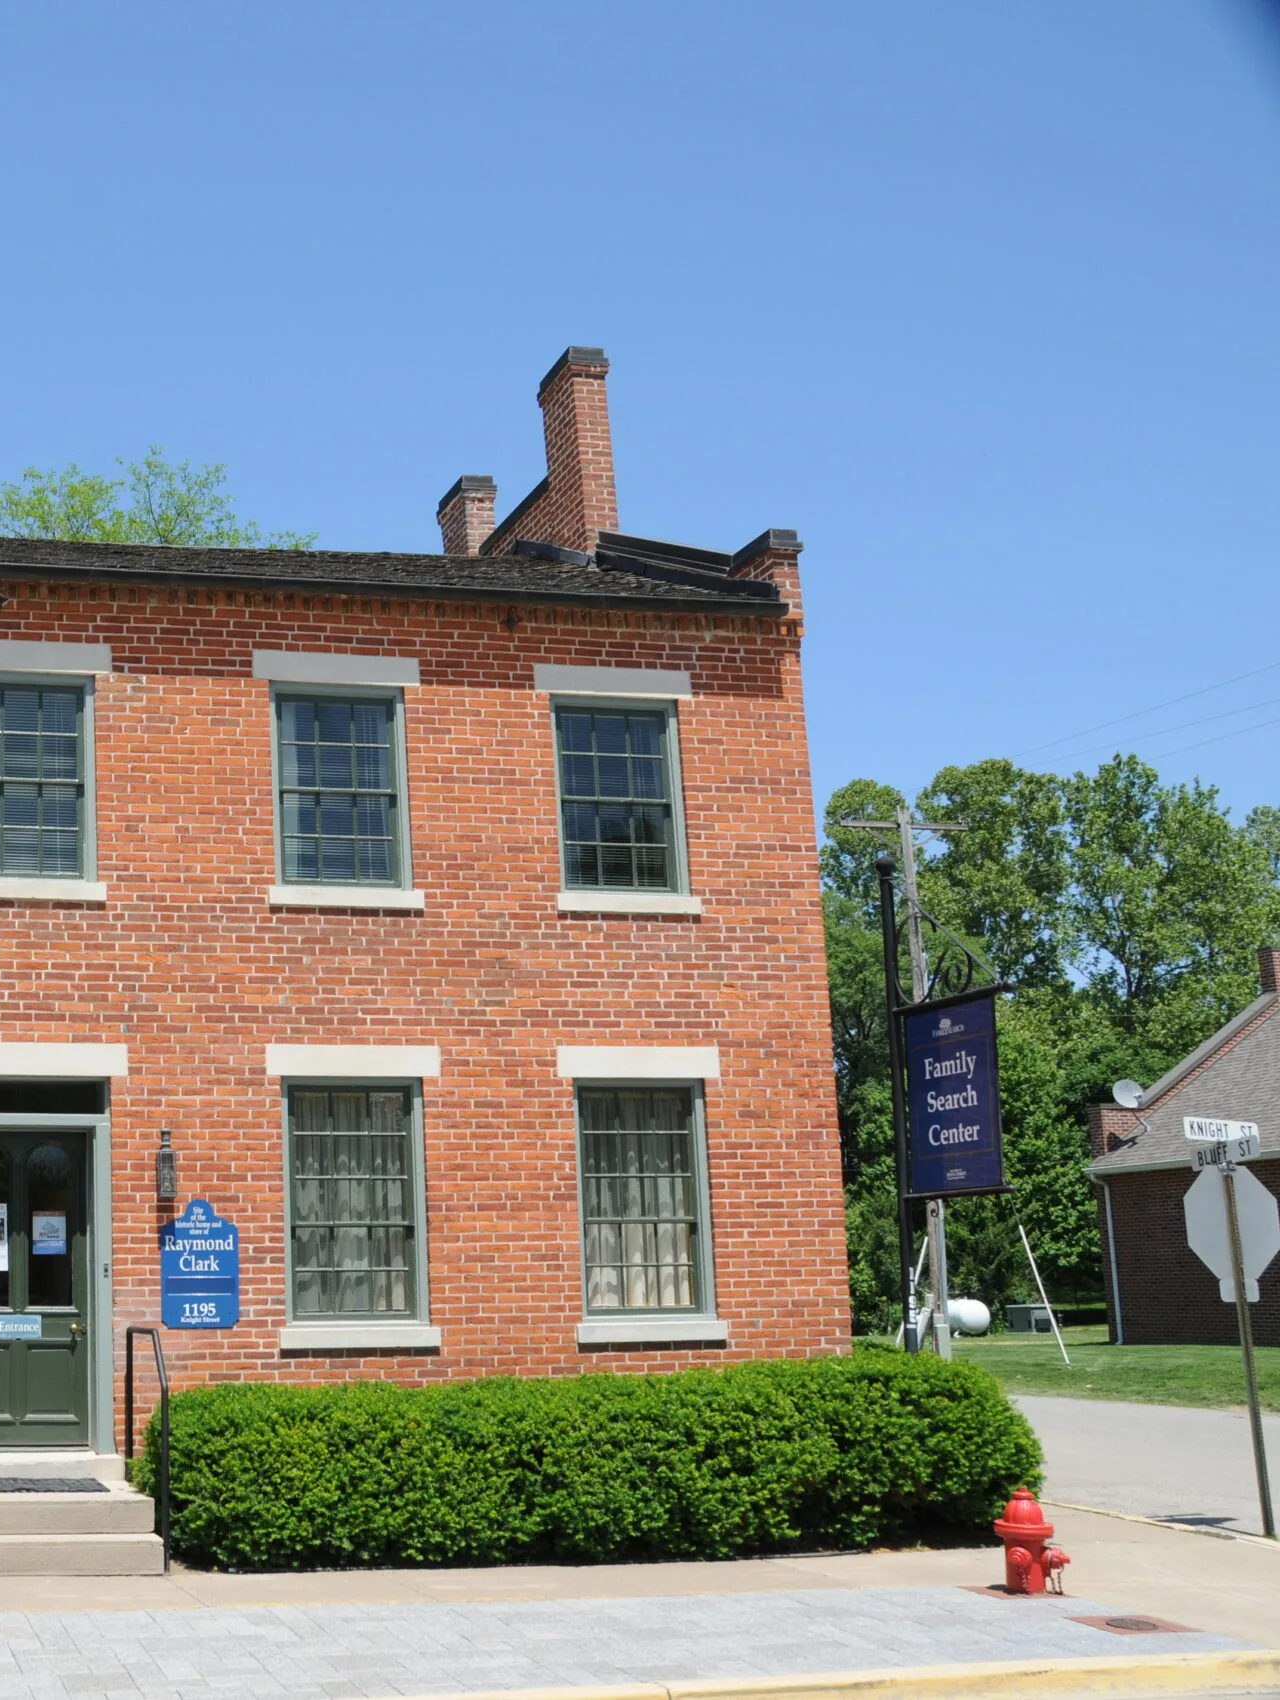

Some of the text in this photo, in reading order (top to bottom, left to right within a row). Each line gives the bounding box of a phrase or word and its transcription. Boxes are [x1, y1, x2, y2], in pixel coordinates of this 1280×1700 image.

[924, 1050, 977, 1080] Family
[927, 1084, 978, 1113] Search
[928, 1122, 980, 1146] Center
[1189, 1120, 1252, 1138] KNIGHT ST
[1197, 1139, 1251, 1166] BLUFF ST
[193, 1206, 204, 1214] Site
[175, 1220, 222, 1228] historic home and
[164, 1234, 234, 1256] Raymond
[179, 1255, 220, 1271] Clark
[183, 1303, 217, 1317] 1195
[0, 1321, 39, 1332] Entrance
